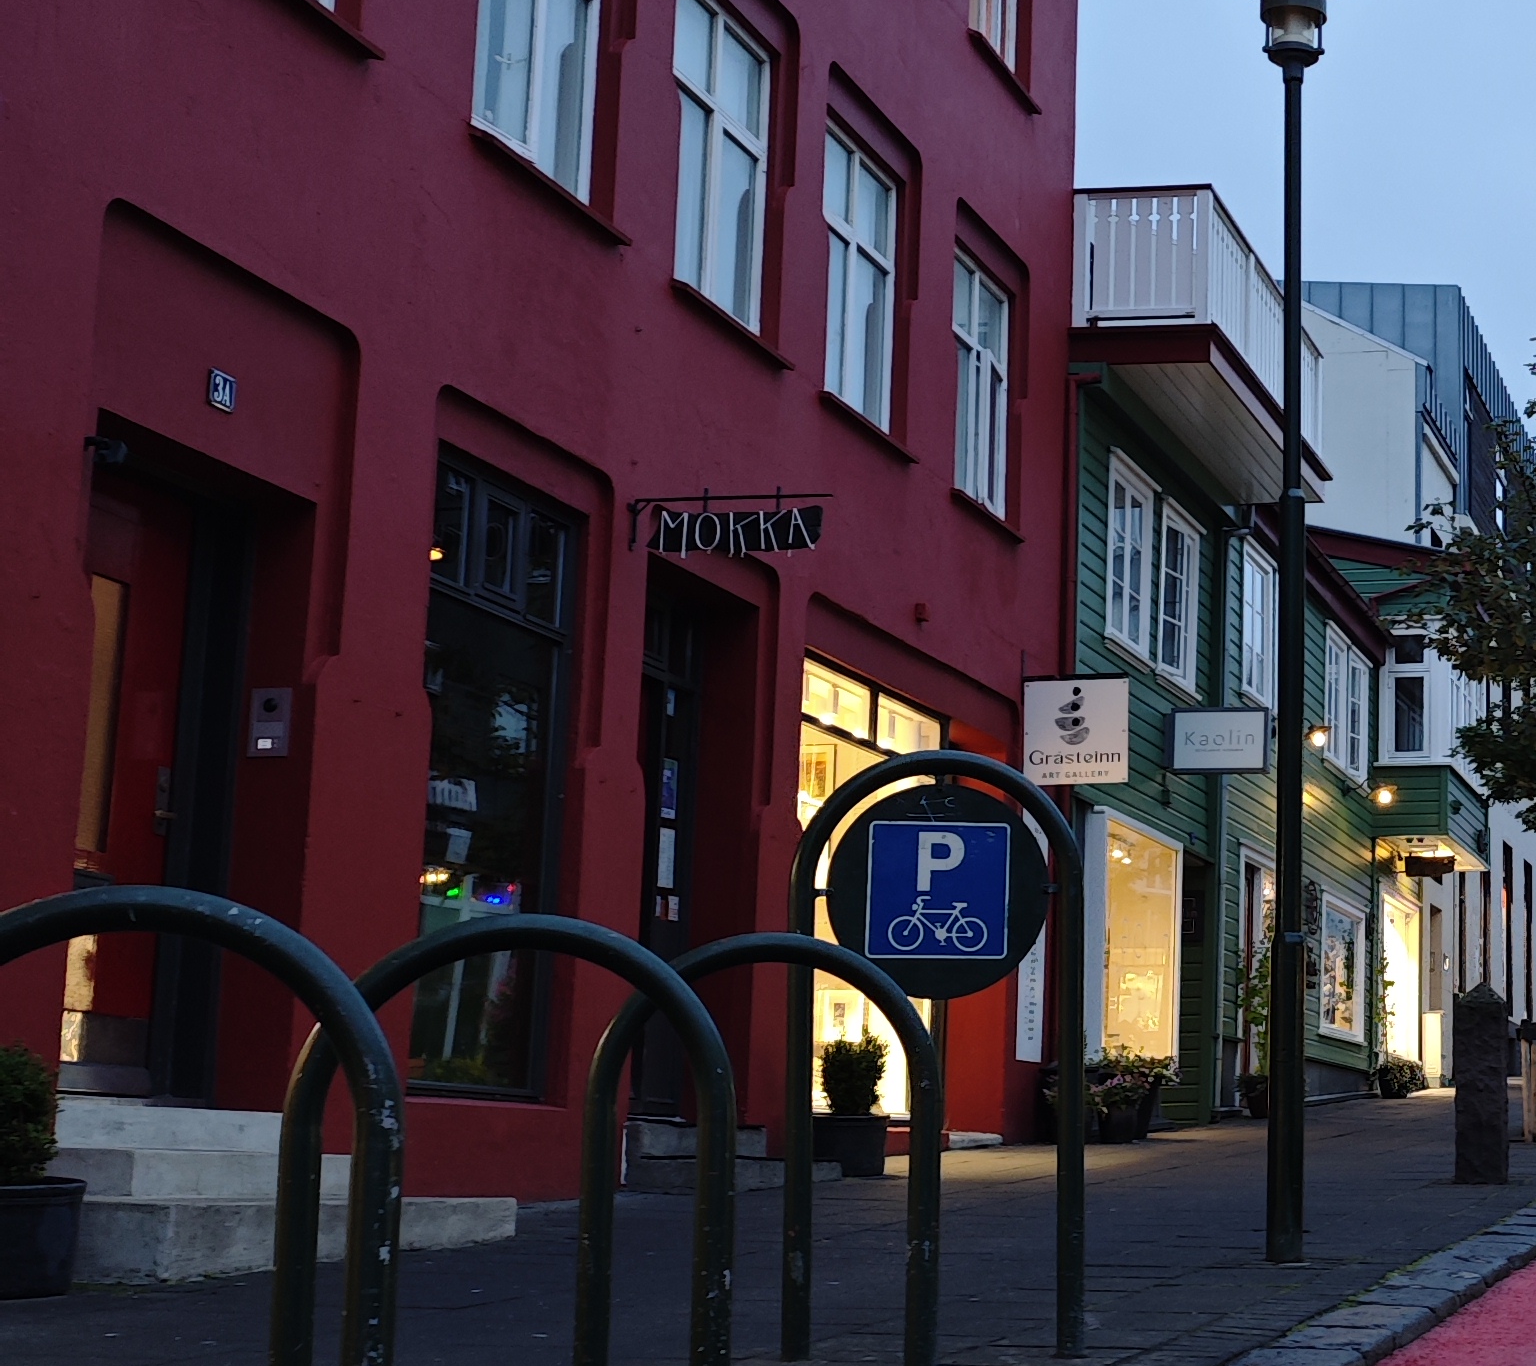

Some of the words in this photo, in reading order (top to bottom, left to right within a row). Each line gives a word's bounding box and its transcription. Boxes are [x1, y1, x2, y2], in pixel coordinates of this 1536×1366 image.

[213, 375, 231, 406] 3A
[658, 507, 816, 559] MOKKA
[1184, 729, 1255, 746] Kaolin
[1041, 771, 1061, 779] ART
[1064, 770, 1109, 779] GALLERY
[916, 831, 966, 892] P
